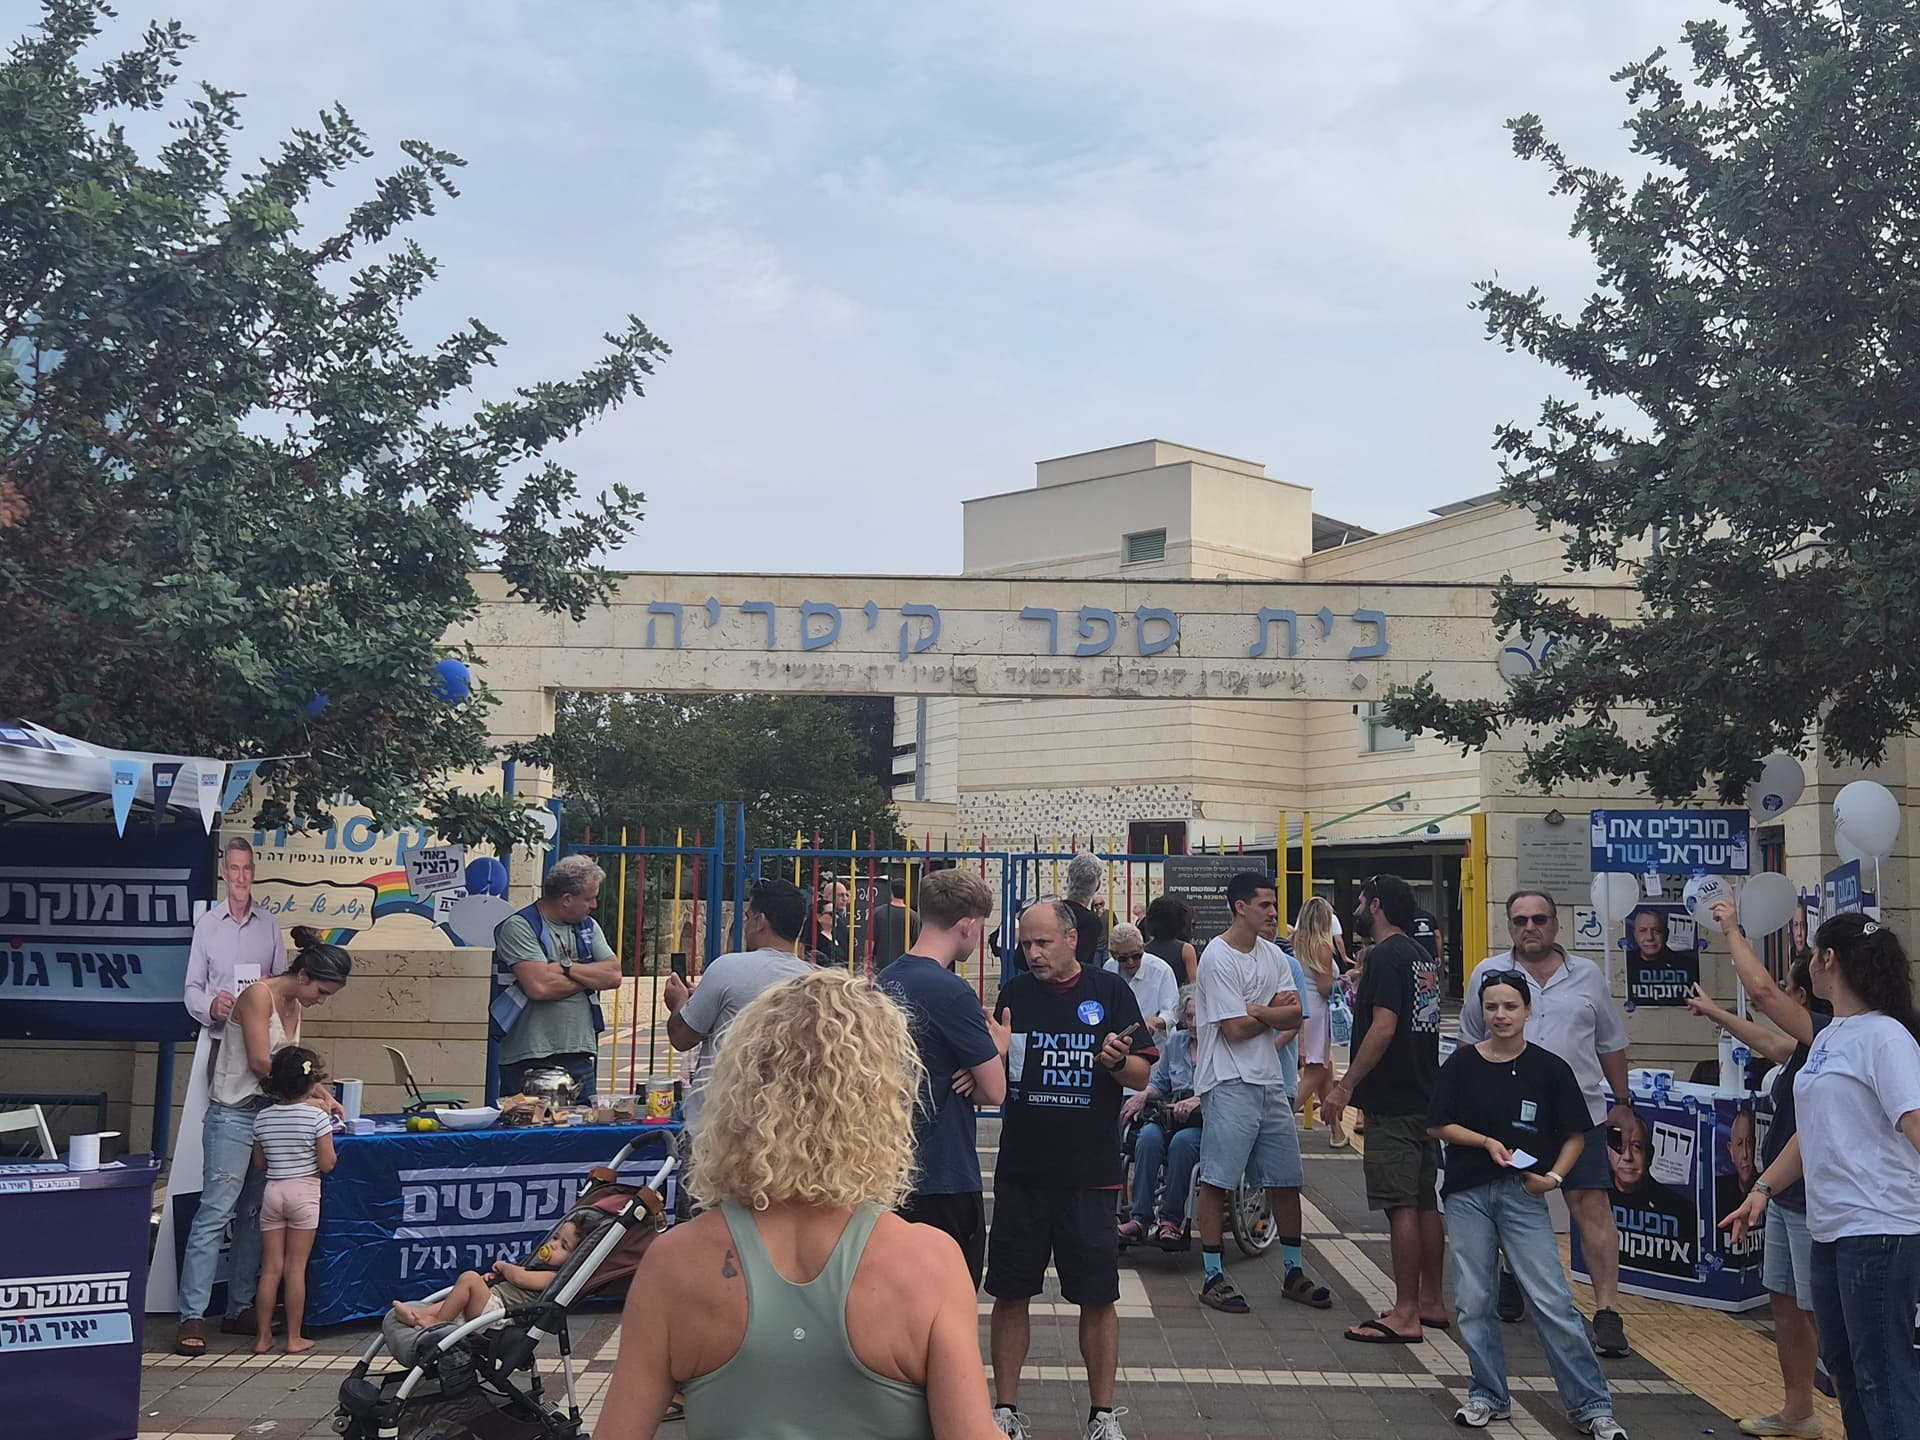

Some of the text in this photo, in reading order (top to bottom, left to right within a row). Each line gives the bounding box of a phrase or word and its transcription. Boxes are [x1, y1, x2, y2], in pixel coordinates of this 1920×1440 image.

[646, 595, 1390, 663] בית ספר קיסריה
[1608, 815, 1730, 839] מובילים את
[267, 851, 284, 862] דה
[288, 852, 325, 864] בנימין
[419, 850, 448, 860] באתי
[1606, 843, 1654, 864] ישר!
[1657, 841, 1732, 865] ישראל
[412, 858, 459, 875] להציל
[309, 893, 327, 913] של
[330, 897, 366, 920] קשת
[56, 952, 143, 989] יאיר
[1639, 969, 1688, 983] הפעם
[1631, 983, 1696, 1001] איזנקוט!
[1031, 1030, 1096, 1050] ישראל
[1040, 1050, 1094, 1069] חייבת
[1042, 1068, 1093, 1088] לנצח
[1059, 1095, 1073, 1104] עם
[1655, 1126, 1692, 1157] דרך
[1612, 1205, 1679, 1238] הפעם
[399, 1240, 533, 1280] יאיר גולן
[46, 1319, 98, 1341] יאיר
